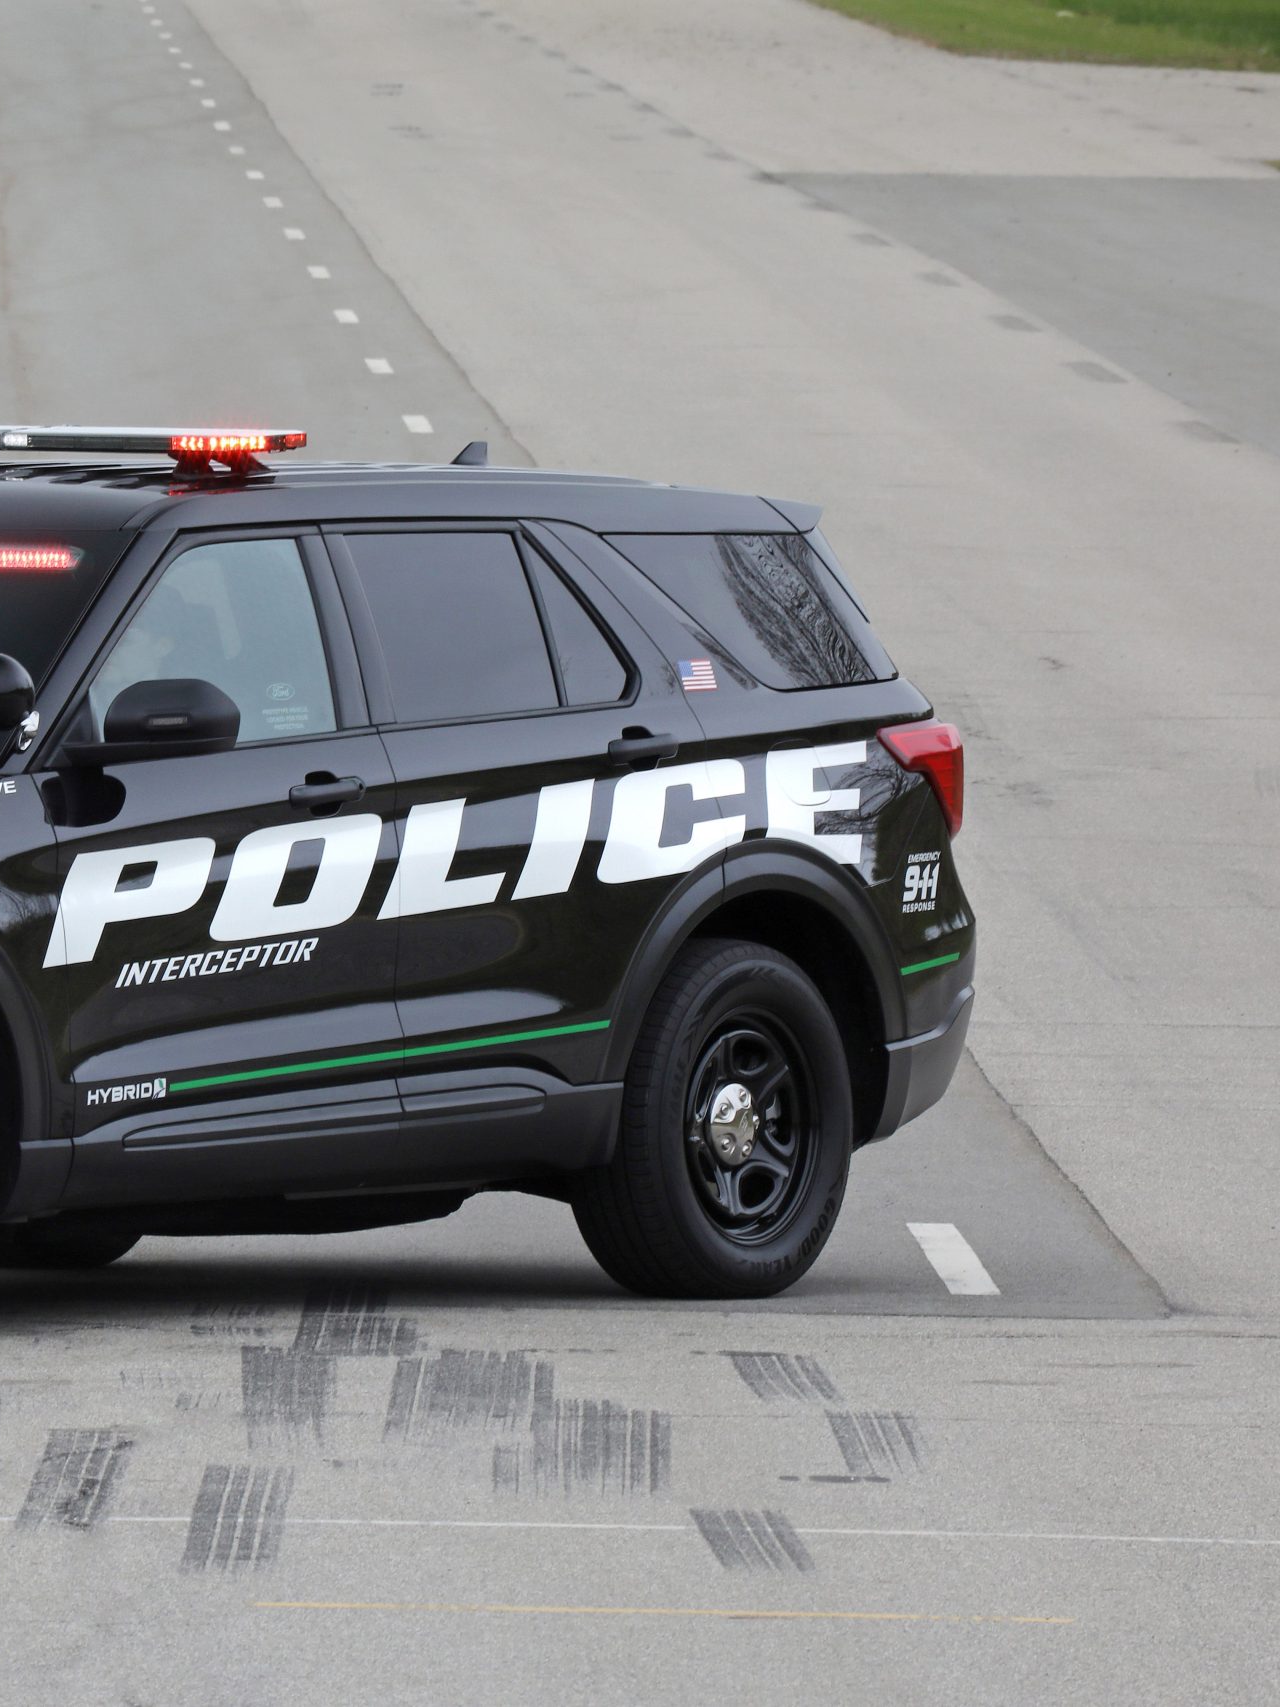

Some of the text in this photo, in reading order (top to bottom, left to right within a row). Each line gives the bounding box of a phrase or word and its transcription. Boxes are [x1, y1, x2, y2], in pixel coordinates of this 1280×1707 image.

[42, 740, 867, 969] POLICE
[907, 850, 941, 864] EMERGENCY
[902, 900, 936, 914] RESPONSE
[114, 937, 320, 989] INTERCEPTOR
[87, 1082, 153, 1106] HYBRID
